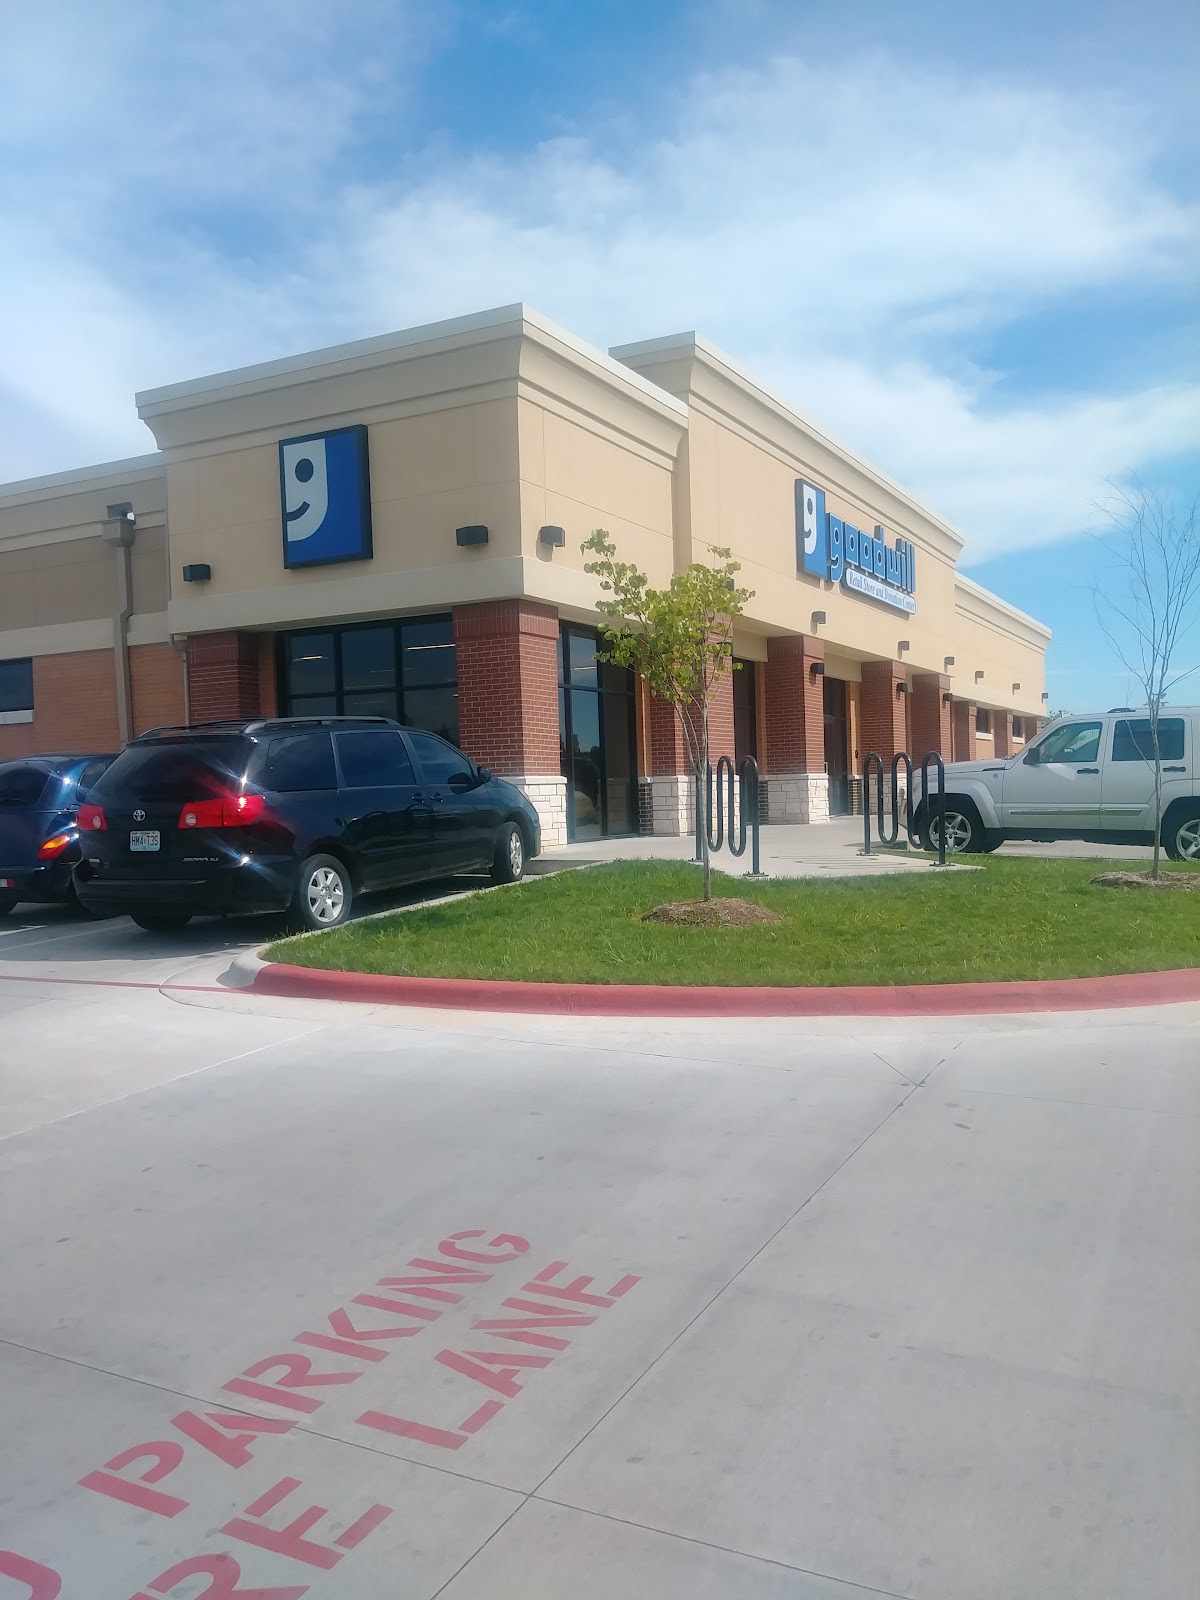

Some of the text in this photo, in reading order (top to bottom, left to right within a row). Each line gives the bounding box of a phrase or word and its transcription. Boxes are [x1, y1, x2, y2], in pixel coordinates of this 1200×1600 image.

[829, 512, 915, 593] goodwill
[849, 571, 915, 612] Retail Store and Donation Center
[77, 1229, 530, 1517] PARKING
[355, 1260, 641, 1450] LANE
